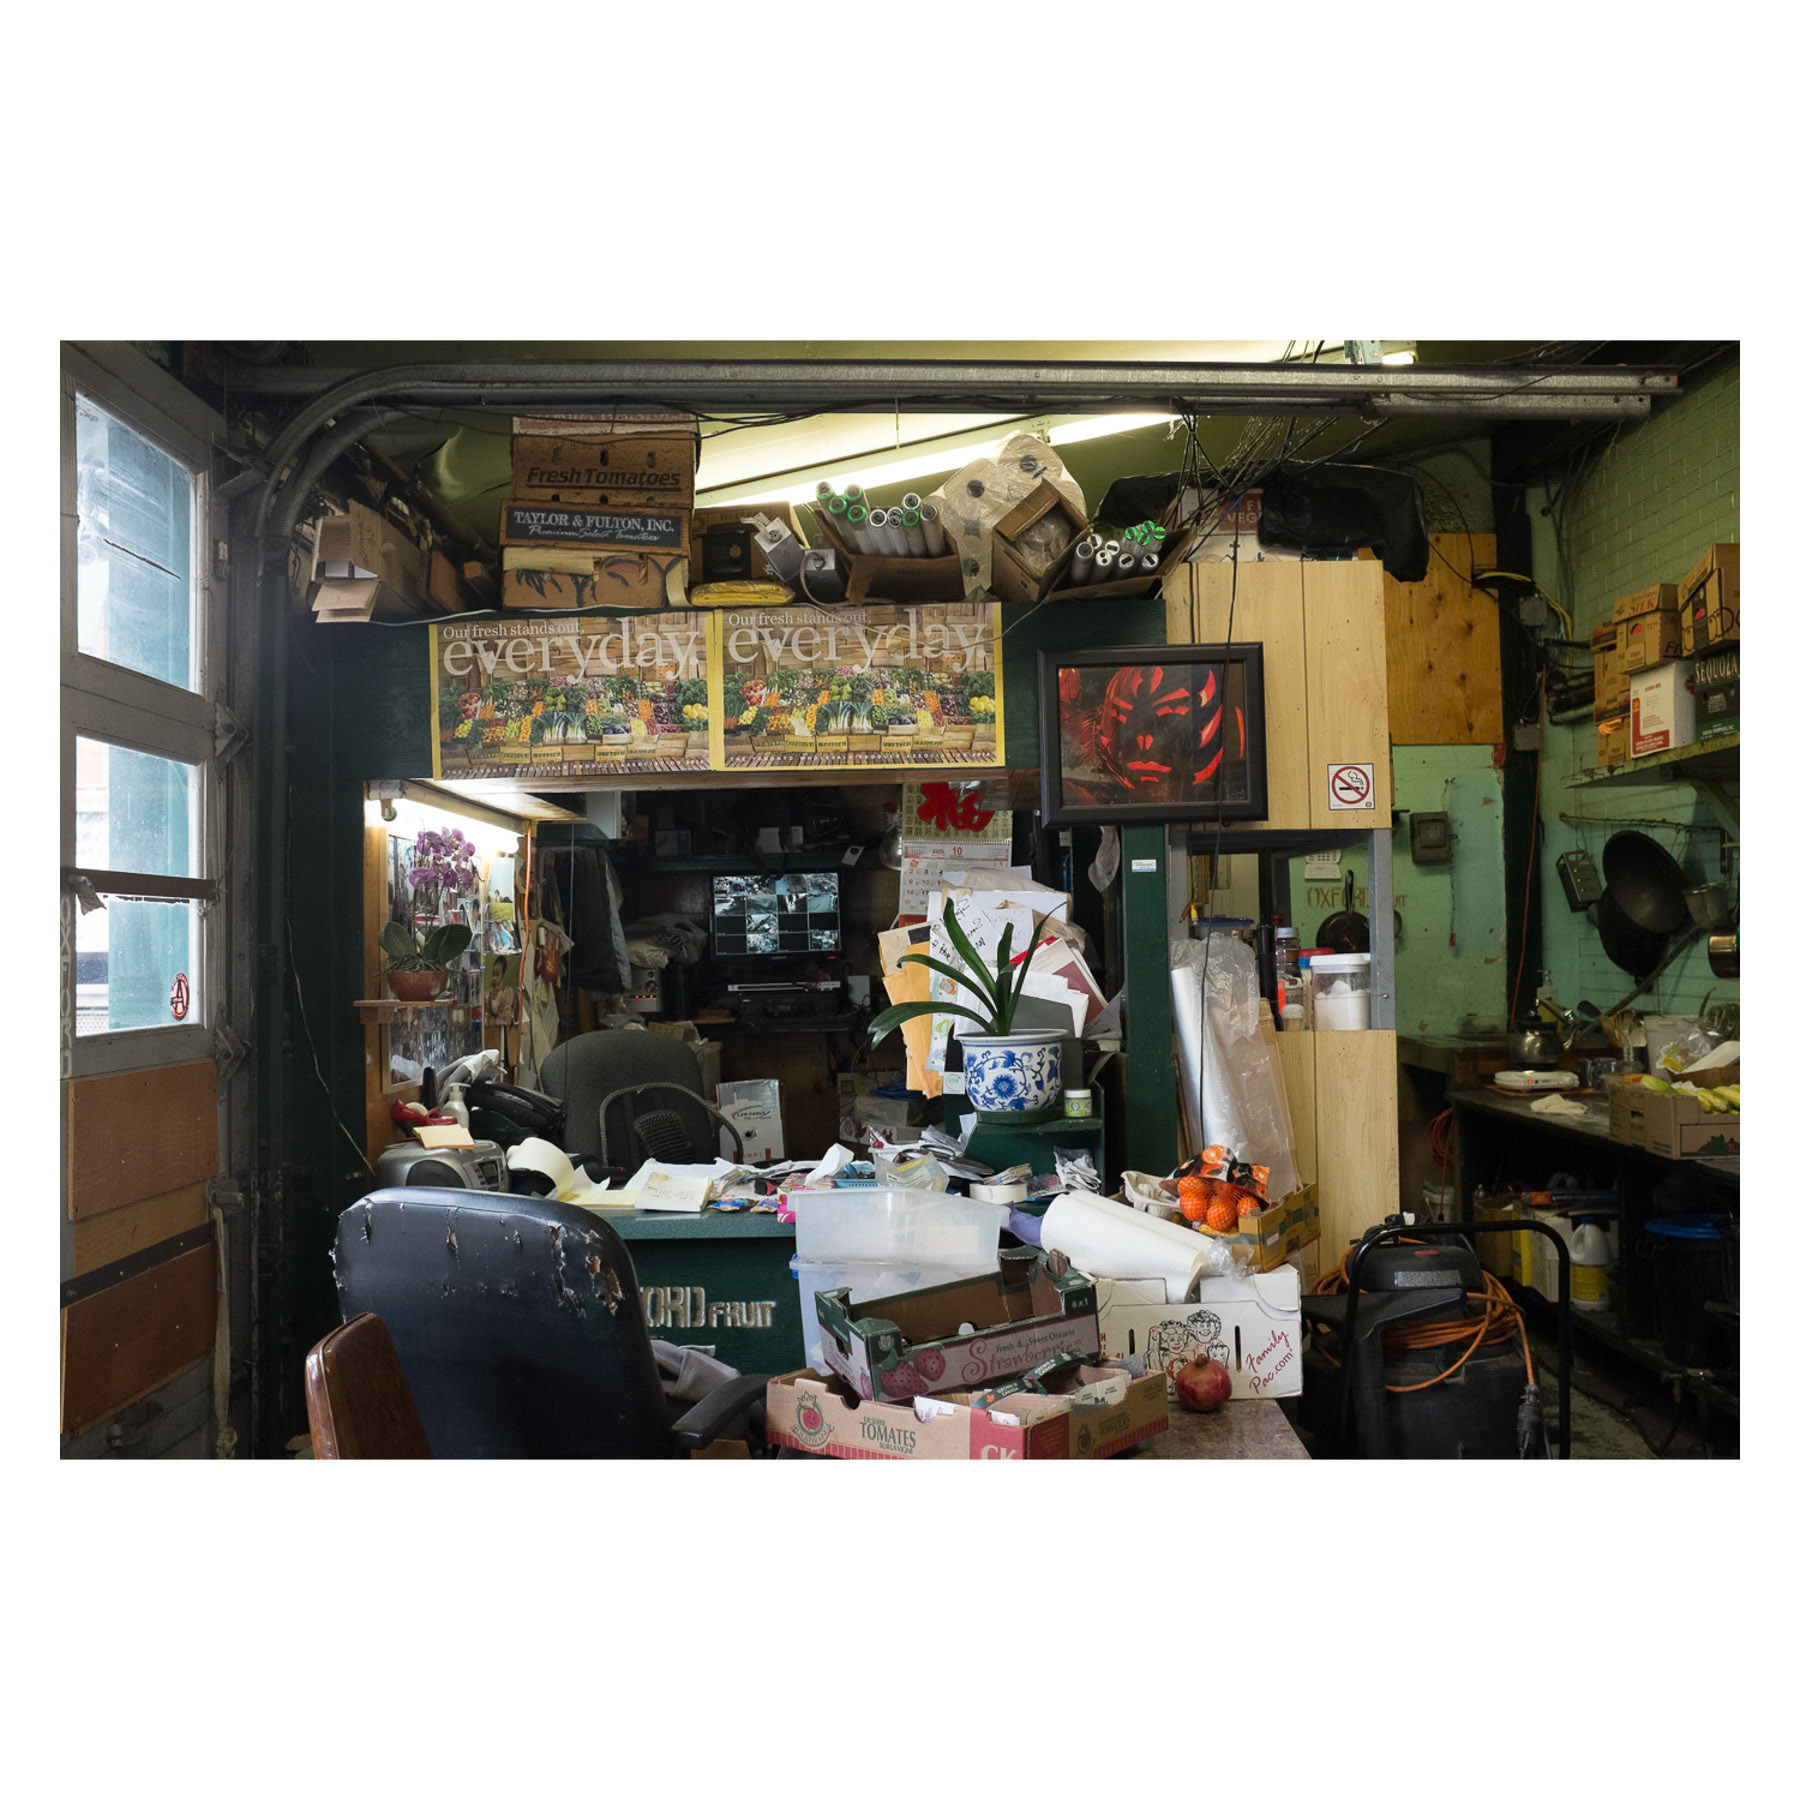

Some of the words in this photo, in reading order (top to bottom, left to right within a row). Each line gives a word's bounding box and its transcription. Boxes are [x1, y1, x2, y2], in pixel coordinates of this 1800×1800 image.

[527, 467, 580, 485] Fresh
[584, 469, 681, 487] Tomatoes
[514, 511, 570, 527] TAYLOR
[572, 515, 584, 527] &
[586, 515, 645, 531] FULTON,
[647, 518, 675, 533] INC.
[528, 525, 579, 538] Premium
[579, 529, 610, 539] Select
[615, 529, 661, 541] Tomatoes
[443, 626, 470, 640] Our
[472, 623, 508, 638] fresh
[510, 622, 554, 636] stands
[728, 613, 756, 627] Our
[759, 612, 793, 625] fresh
[796, 611, 839, 625] stands
[443, 617, 699, 684] everyday.
[728, 608, 987, 673] everyday.
[707, 1300, 777, 1328] FRUIT
[996, 1342, 1016, 1353] Fresh
[1049, 1330, 1076, 1341] Ontario
[1246, 1329, 1289, 1373] Family
[961, 1338, 1083, 1385] Strawberries
[859, 1421, 917, 1449] TOMATES
